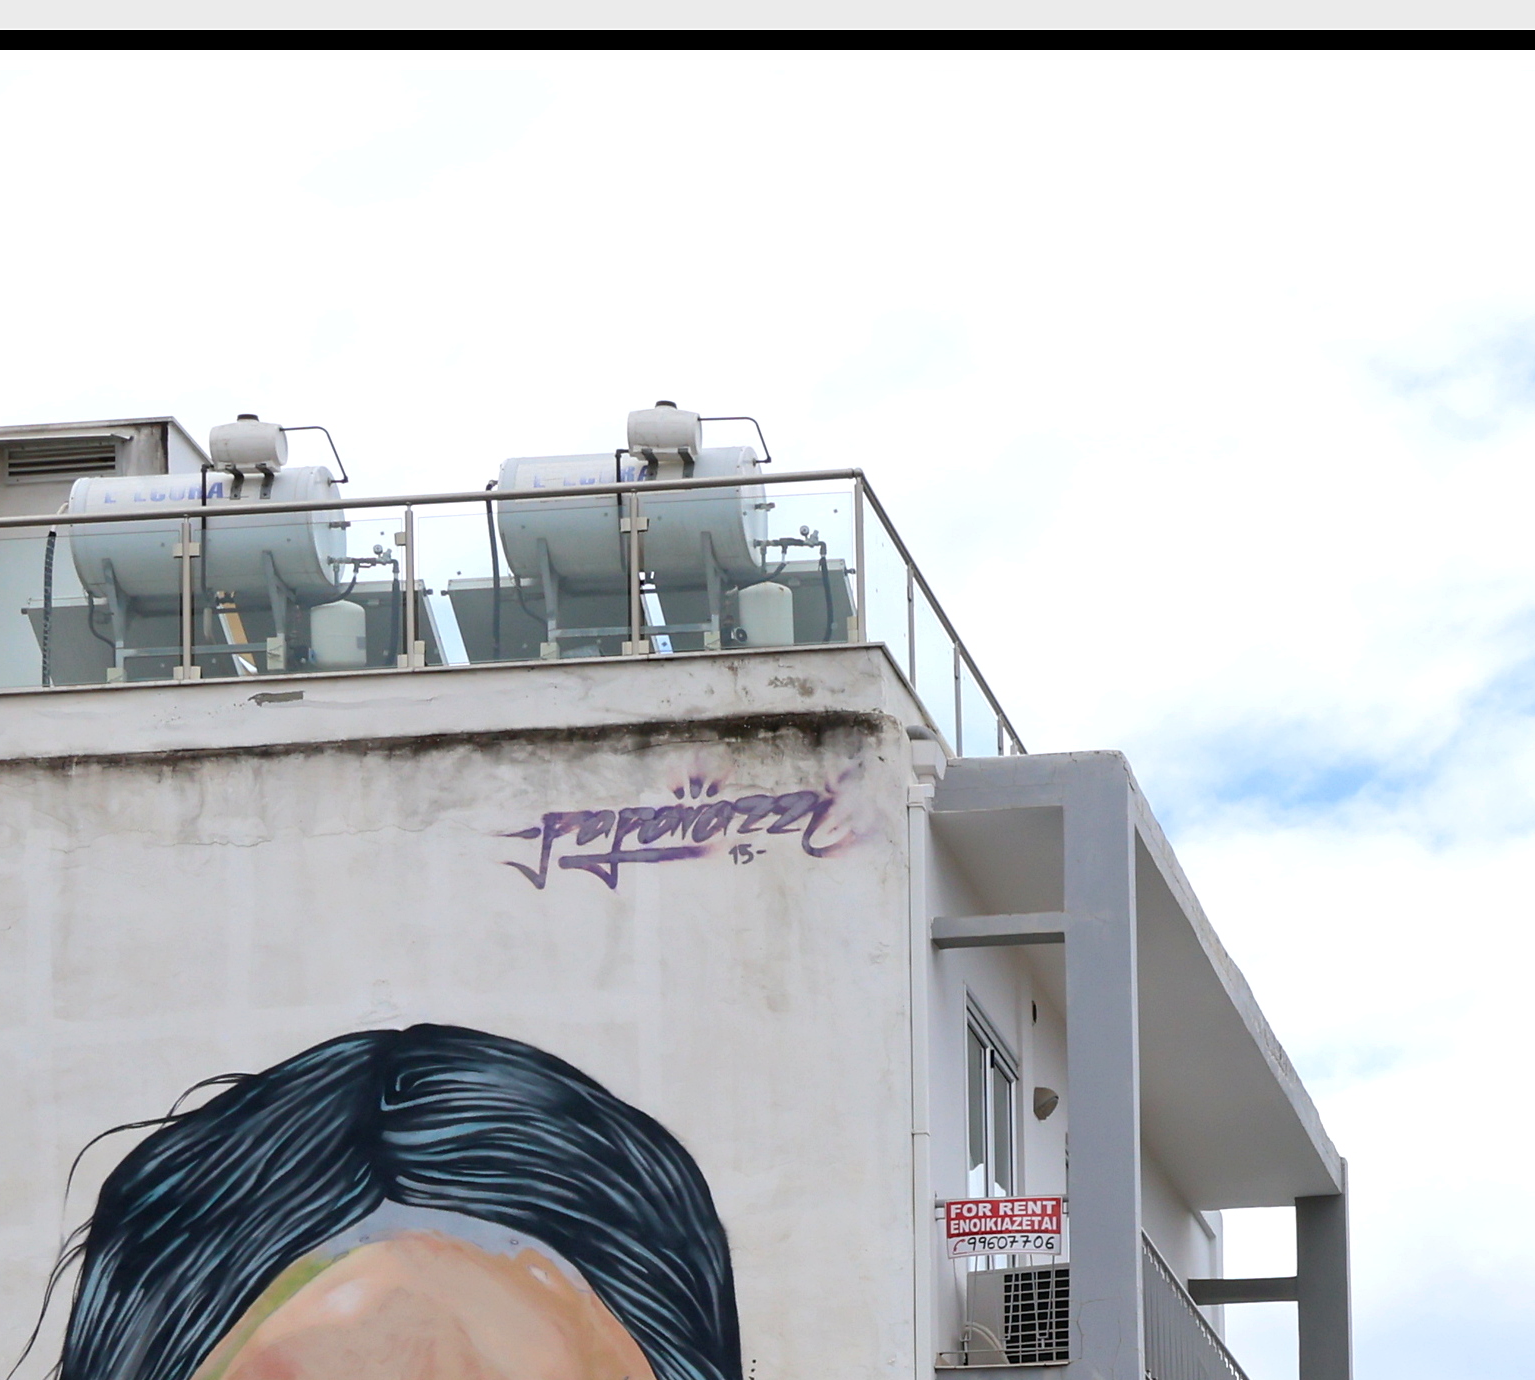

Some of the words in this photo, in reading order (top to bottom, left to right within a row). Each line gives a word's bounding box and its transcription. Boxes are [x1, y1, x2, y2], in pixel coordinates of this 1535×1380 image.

[950, 1203, 992, 1218] FOR
[999, 1201, 1056, 1216] RENT
[950, 1217, 1056, 1234] ΕΝΟΙΚΙΑΖΕΤΑΙ
[967, 1235, 1054, 1251] 99607706
